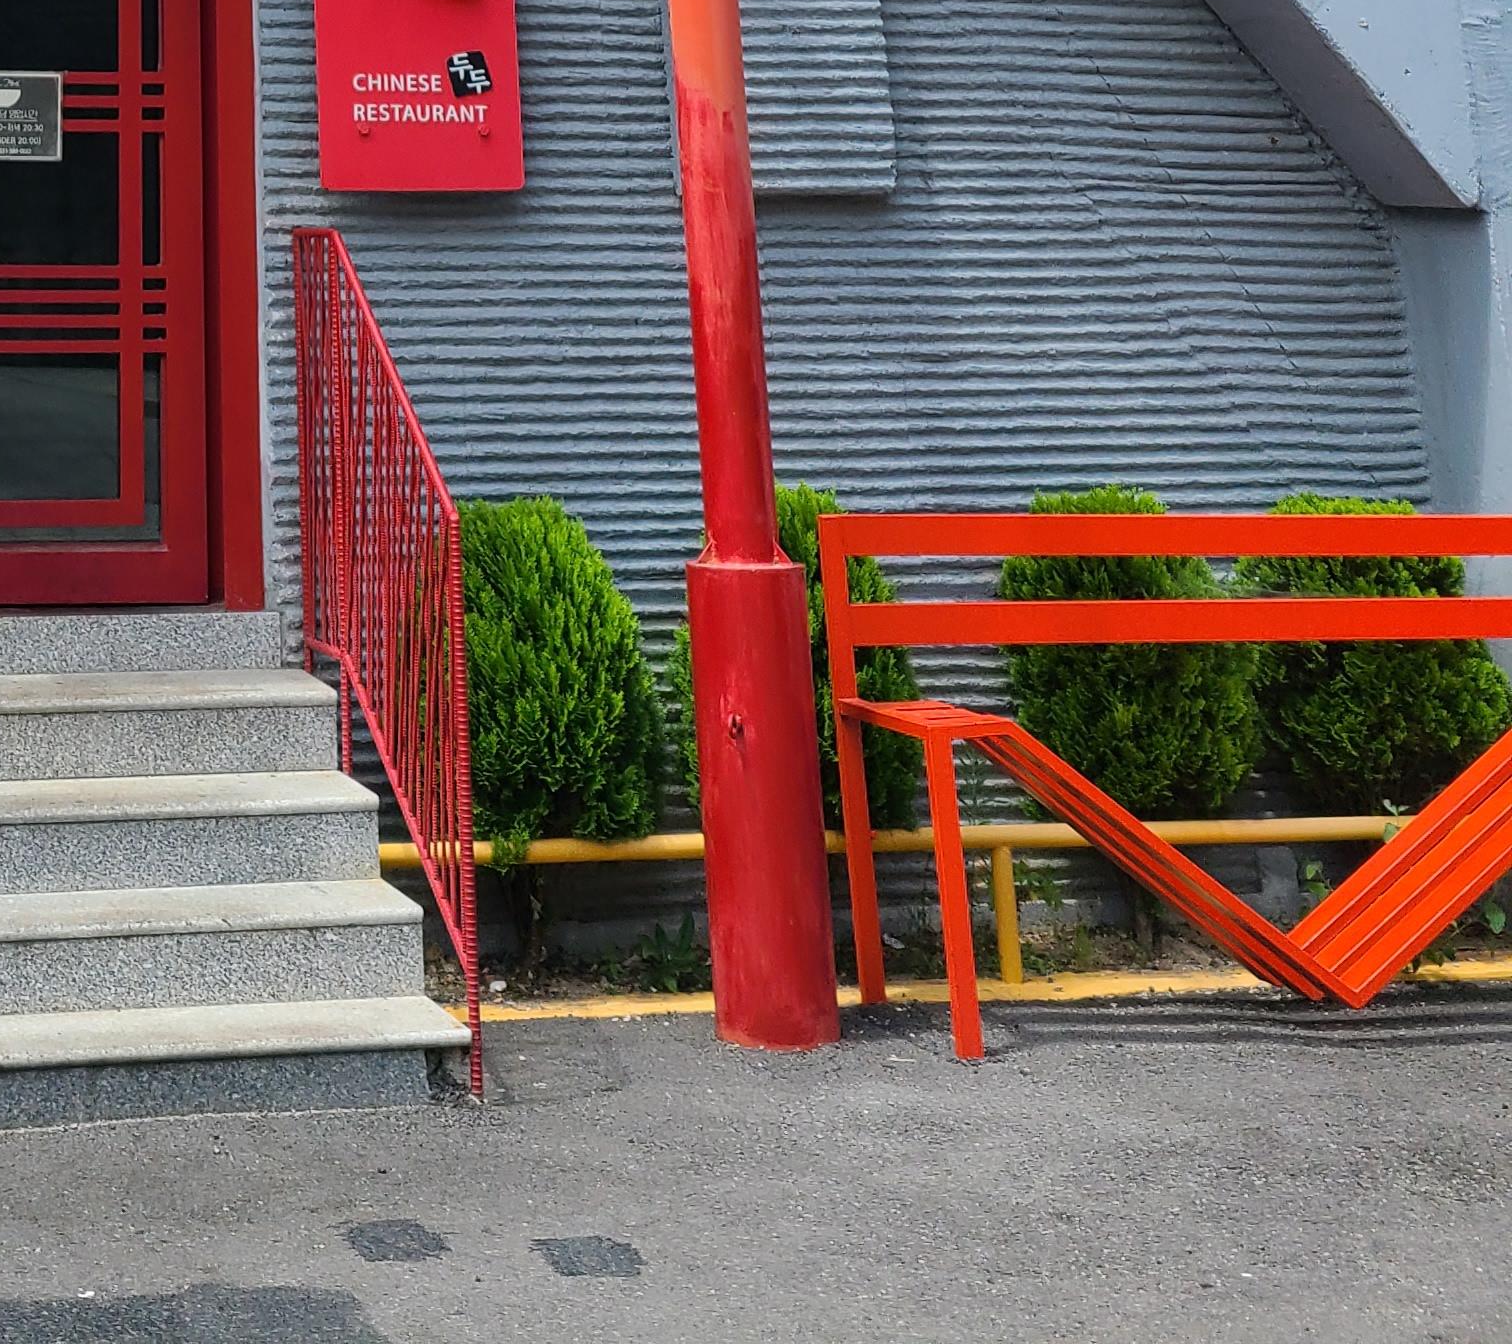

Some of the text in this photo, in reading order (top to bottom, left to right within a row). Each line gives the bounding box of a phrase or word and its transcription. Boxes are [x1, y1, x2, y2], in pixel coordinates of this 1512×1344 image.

[352, 73, 442, 92] CHINESE
[448, 52, 491, 95] 두두
[353, 103, 488, 123] RESTAURANT
